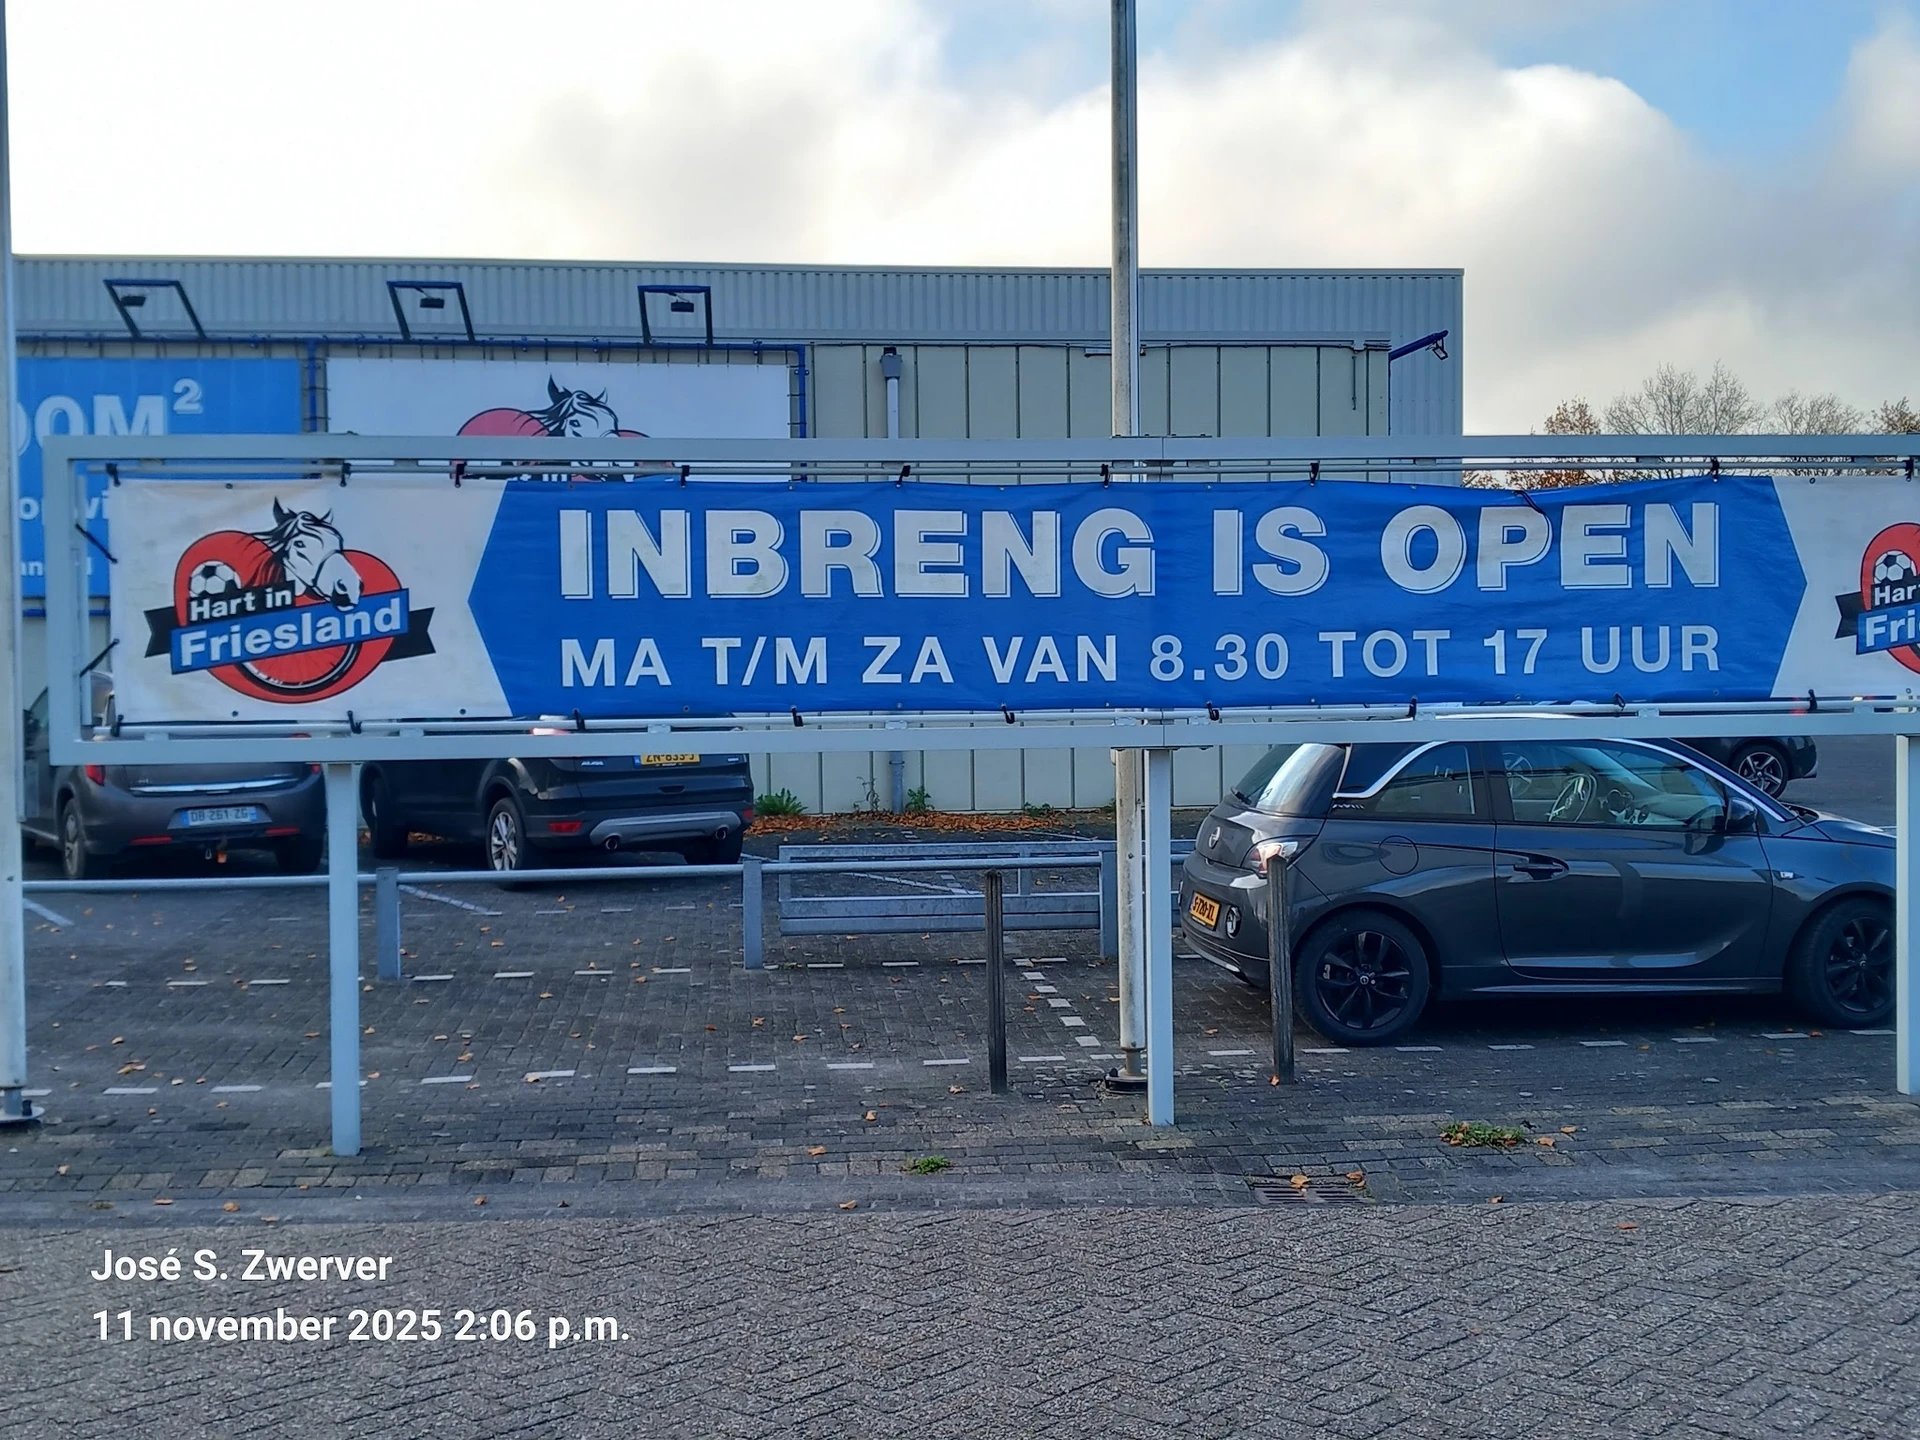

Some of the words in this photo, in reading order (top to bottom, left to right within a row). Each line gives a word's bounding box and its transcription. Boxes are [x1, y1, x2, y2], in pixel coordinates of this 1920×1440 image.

[560, 509, 1155, 598] INBRENG
[1214, 507, 1329, 595] IS
[1381, 503, 1718, 594] OPEN
[190, 592, 255, 621] Hart
[265, 587, 292, 608] in
[1874, 584, 1920, 606] Har
[180, 597, 401, 667] Friesland
[1866, 609, 1920, 647] Fri
[562, 638, 671, 687] MA
[702, 636, 826, 685] T/M
[863, 636, 953, 683] ZA
[983, 636, 1116, 683] VAN
[1151, 633, 1288, 681] 8.30
[1320, 631, 1449, 678] TOT
[1484, 629, 1546, 674] 17
[1582, 626, 1719, 673] UUR
